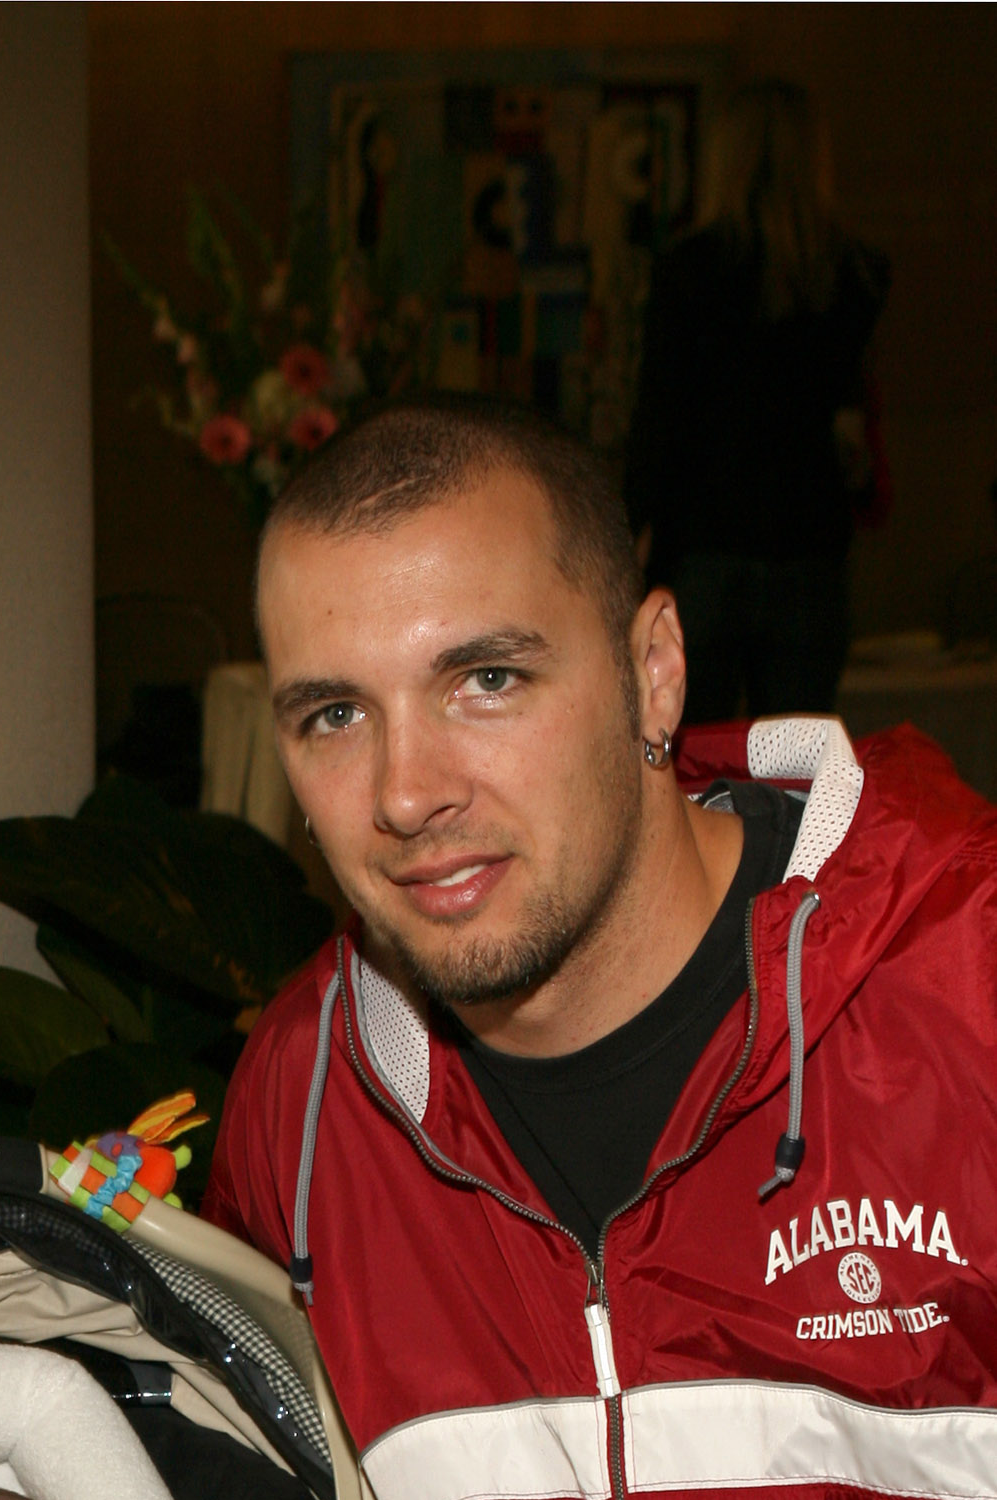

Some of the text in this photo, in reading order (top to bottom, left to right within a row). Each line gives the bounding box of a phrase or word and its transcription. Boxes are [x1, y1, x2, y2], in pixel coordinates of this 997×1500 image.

[765, 1198, 961, 1286] ALABAMA
[846, 1262, 875, 1295] SEC
[796, 1309, 893, 1340] CRIMSON
